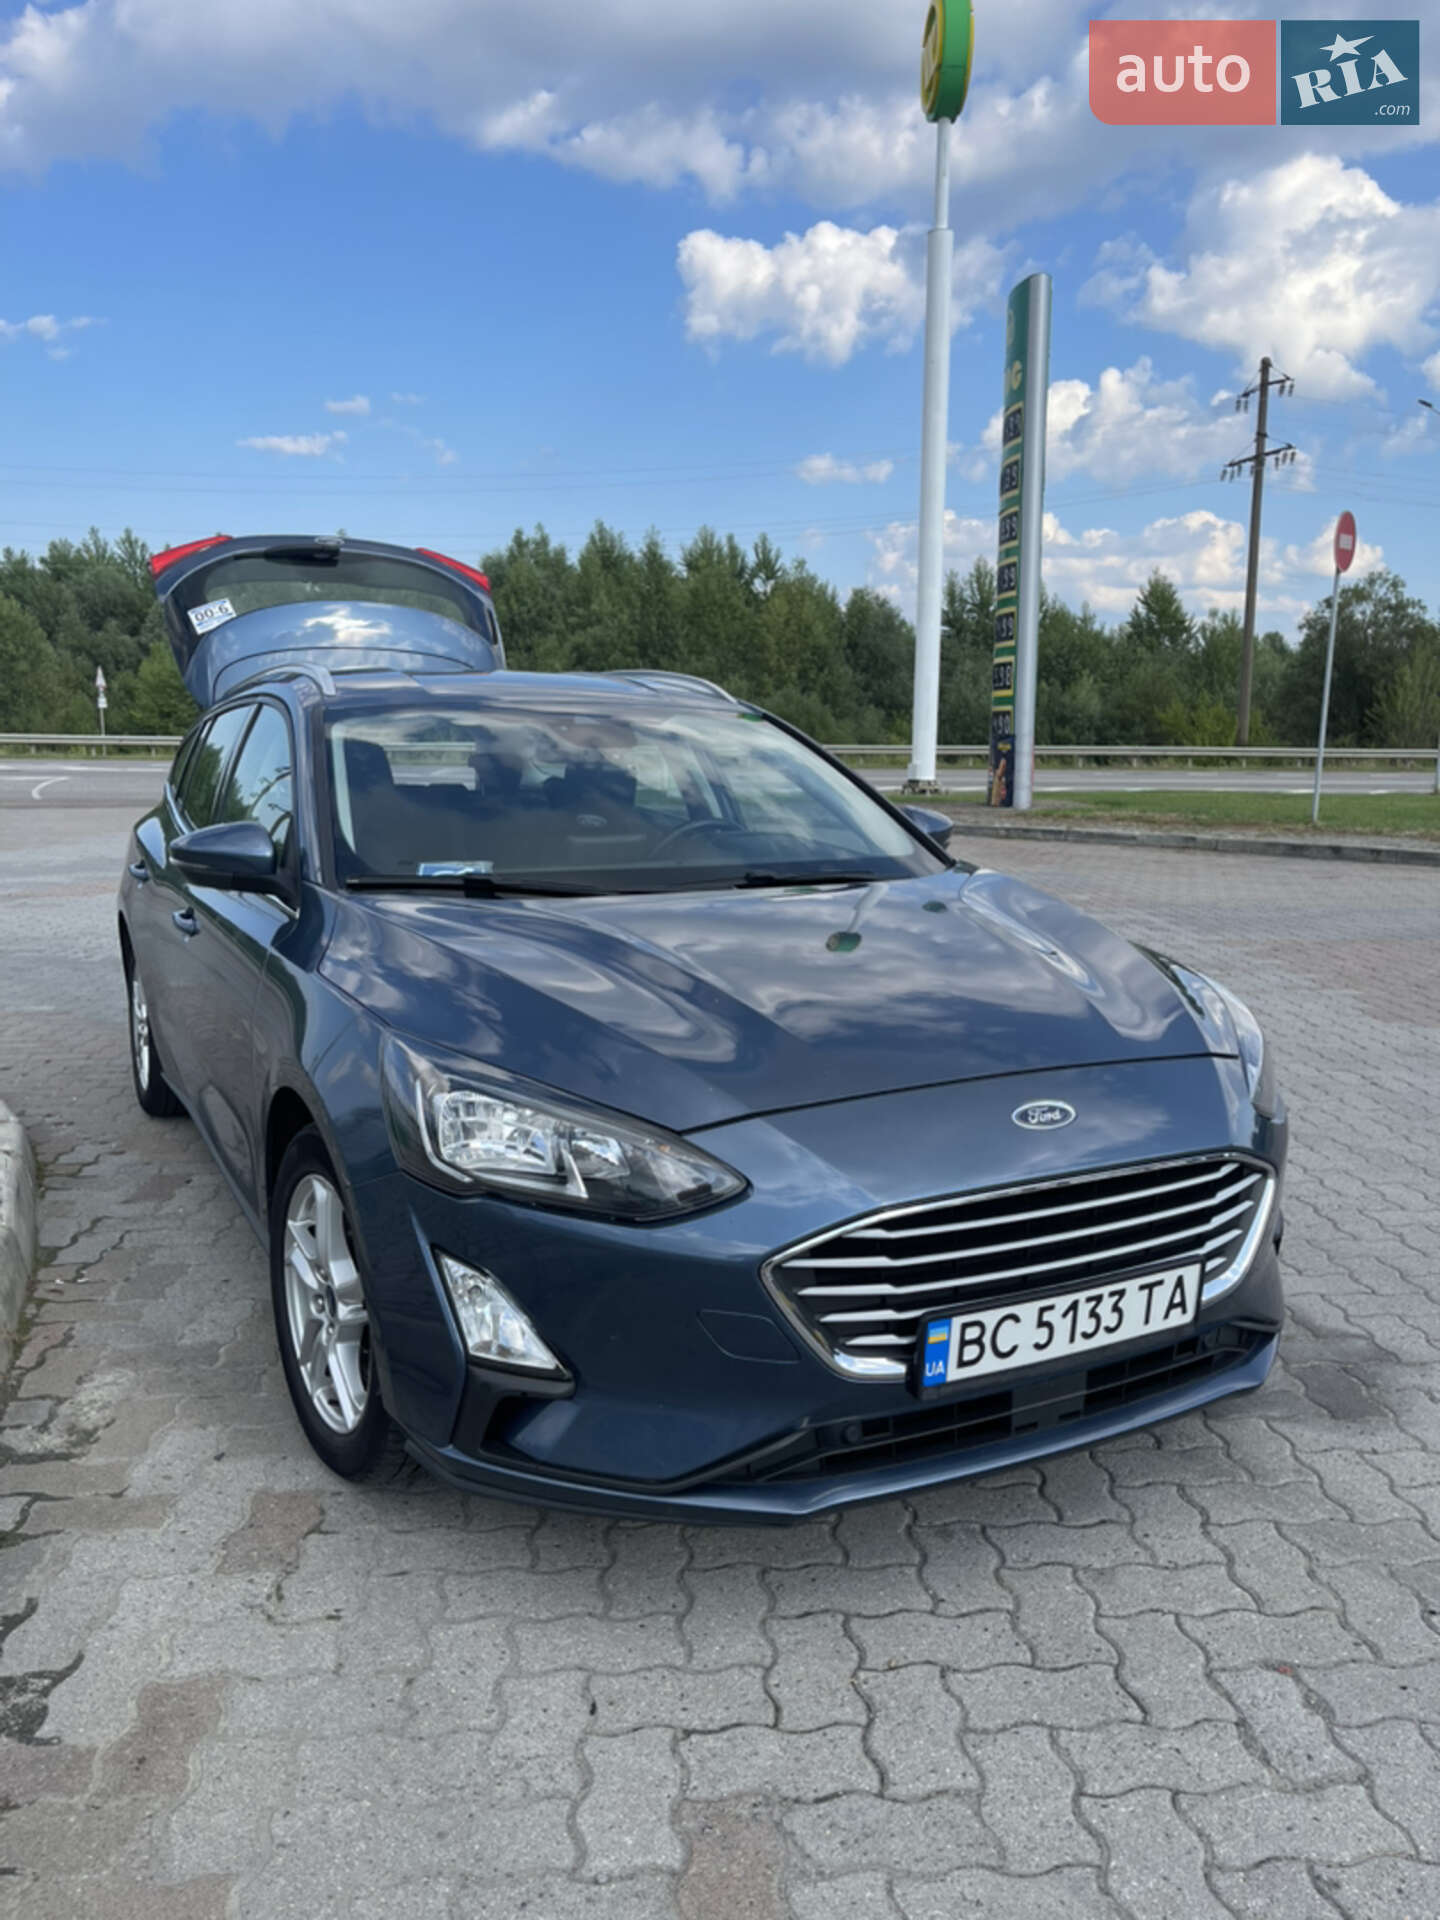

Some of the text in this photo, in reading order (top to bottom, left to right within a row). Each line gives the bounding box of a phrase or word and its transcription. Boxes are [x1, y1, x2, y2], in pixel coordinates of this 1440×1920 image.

[1027, 1106, 1062, 1124] Ford
[956, 1274, 1187, 1369] BC 5133 TA
[925, 1360, 946, 1377] UA
